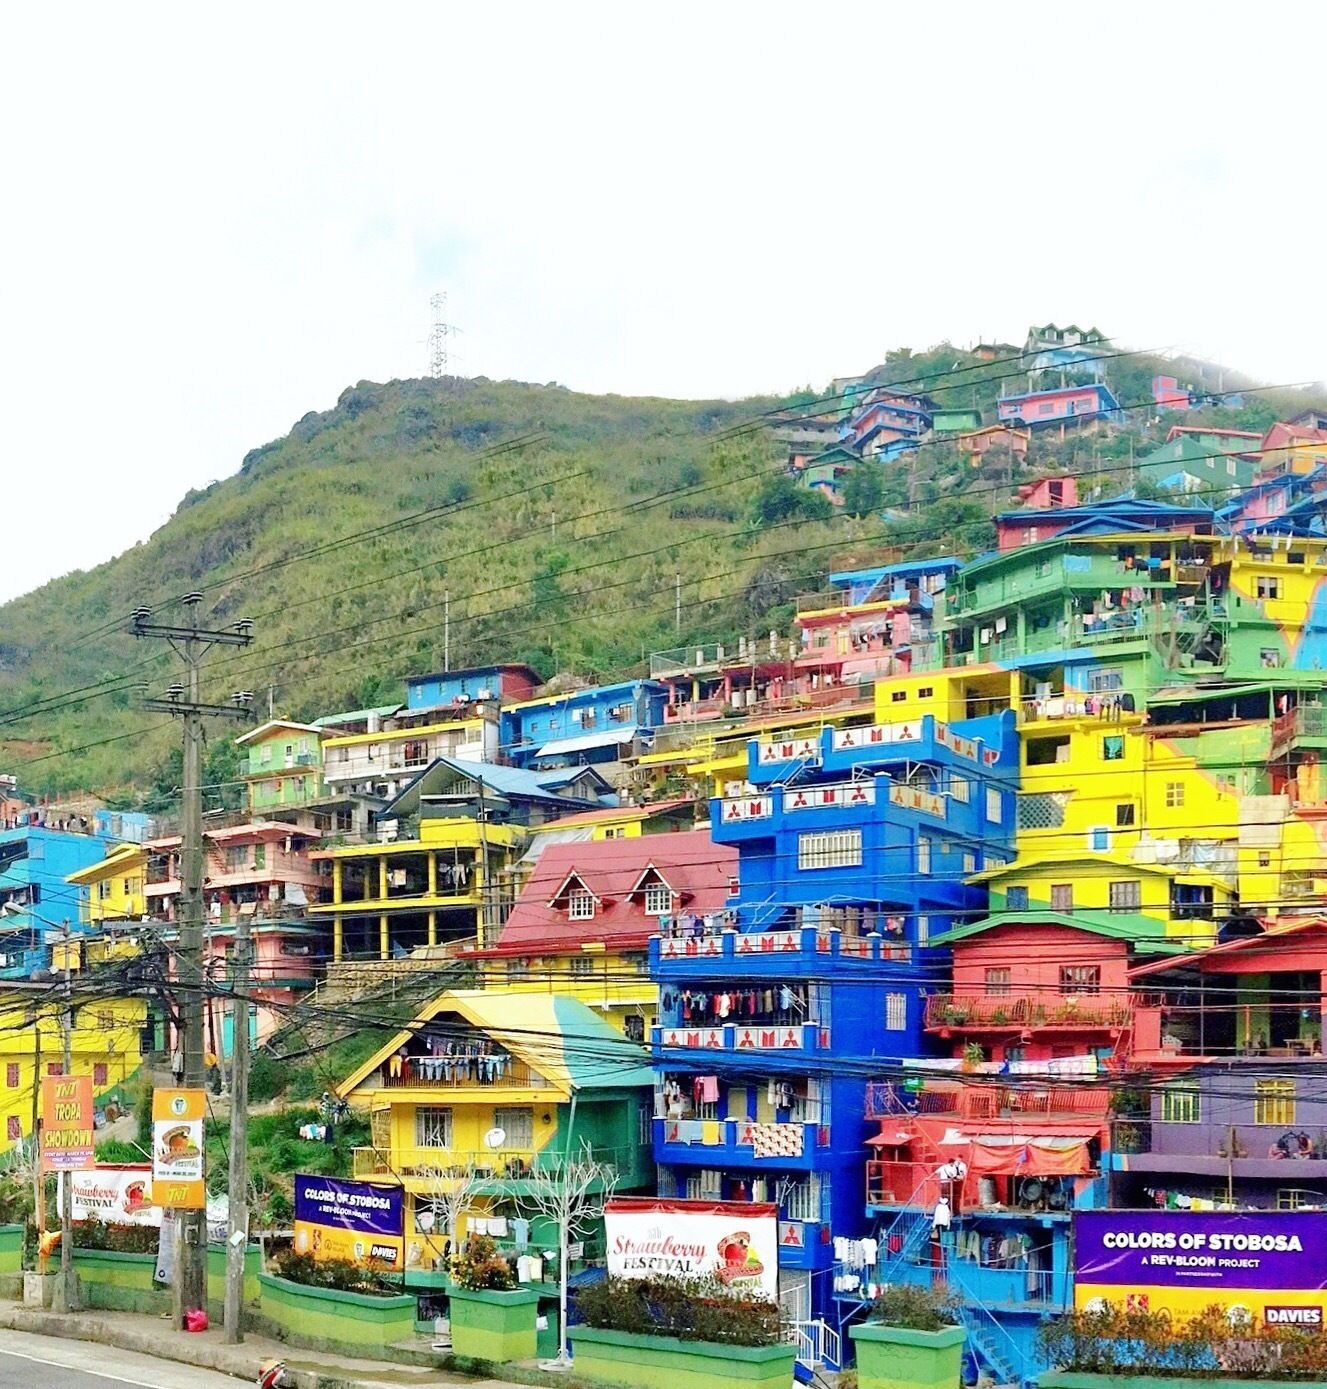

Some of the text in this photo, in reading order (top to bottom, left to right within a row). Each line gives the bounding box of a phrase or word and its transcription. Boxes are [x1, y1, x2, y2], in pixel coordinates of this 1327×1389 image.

[55, 1081, 78, 1098] TNT
[55, 1102, 81, 1120] TROPA
[45, 1129, 93, 1148] SHOWDOWN
[70, 1183, 119, 1202] trawberry
[168, 1186, 189, 1201] TNT
[304, 1188, 391, 1210] COLORS OF STOBOSA
[75, 1197, 114, 1208] FESTIVAL
[613, 1234, 707, 1265] Strawberry
[1103, 1232, 1303, 1252] COLORS OF STOBOSA
[371, 1246, 397, 1259] DAVIES
[1141, 1254, 1260, 1268] A REV-BLOOM PROJECT
[623, 1256, 693, 1273] FESTIVAL
[1267, 1309, 1320, 1323] DAVIES
